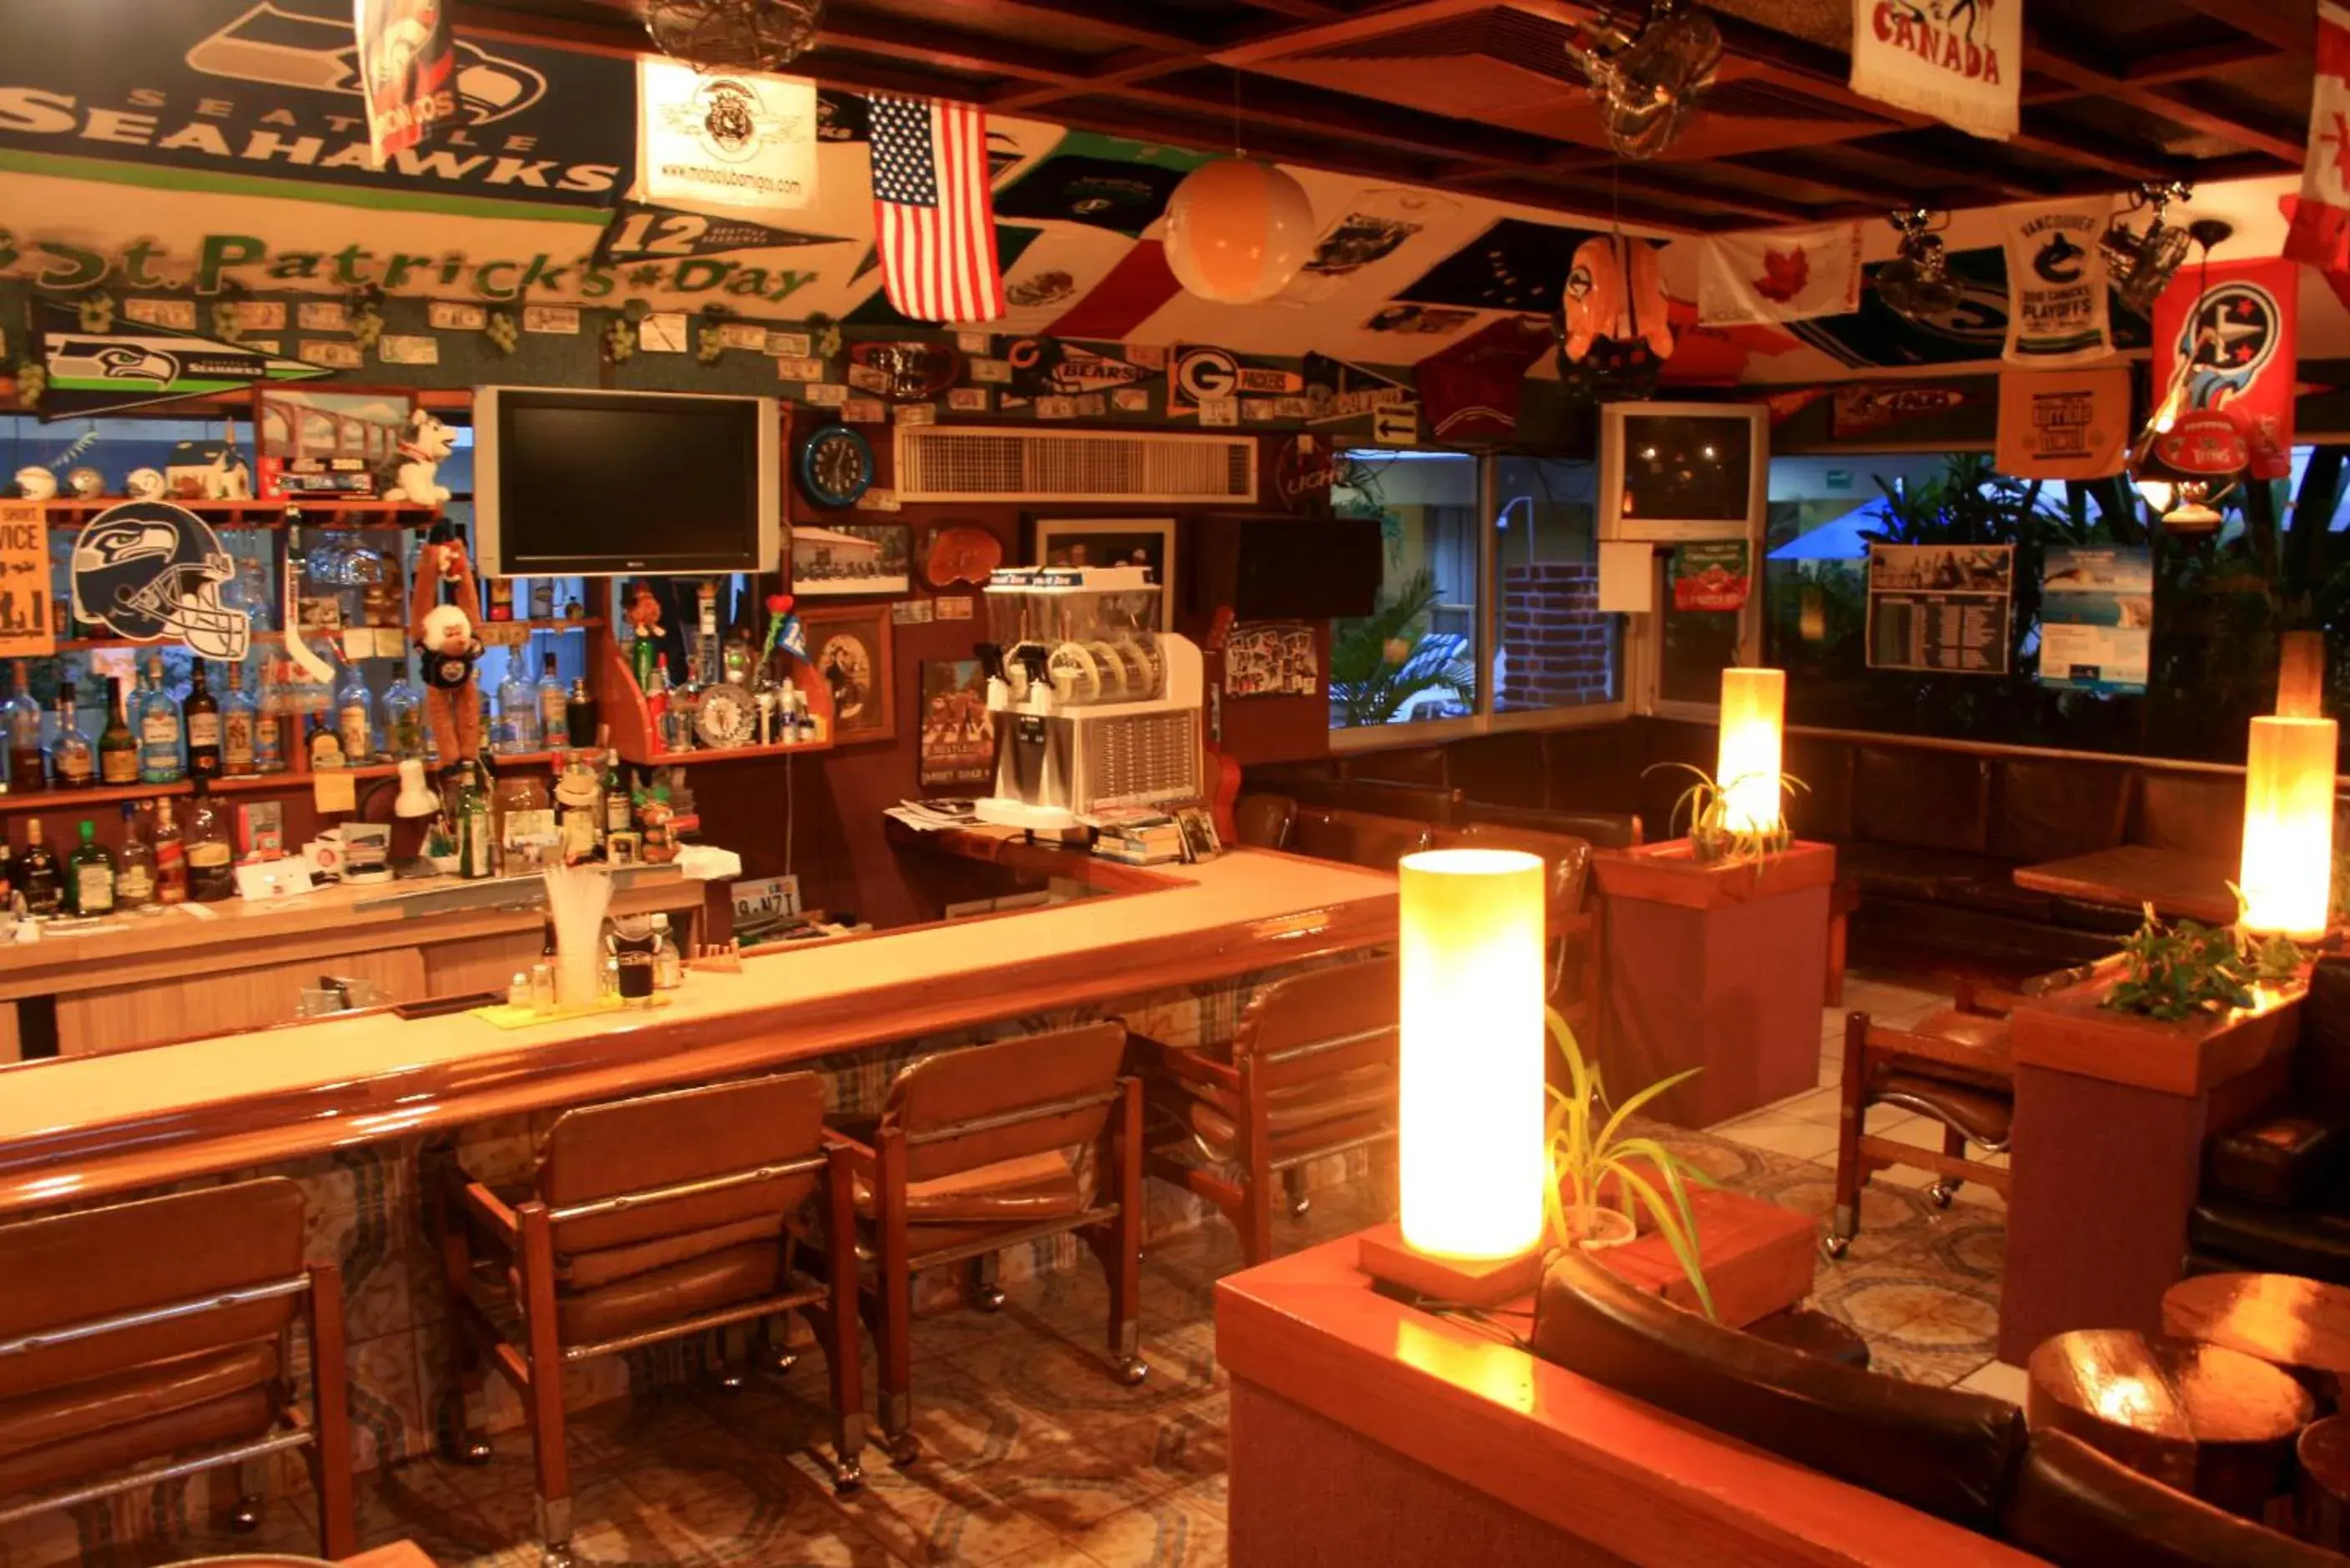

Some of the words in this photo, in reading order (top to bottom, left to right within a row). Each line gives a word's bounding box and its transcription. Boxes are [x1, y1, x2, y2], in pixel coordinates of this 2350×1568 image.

[1872, 1, 2000, 85] CANADA
[0, 87, 621, 193] SEAHAWKS
[127, 88, 539, 151] SEATLE
[611, 214, 709, 254] 12
[2020, 214, 2097, 238] VANCOUVER
[35, 239, 180, 289] St.
[673, 260, 819, 303] Day
[2022, 297, 2092, 319] PLAYOFFS
